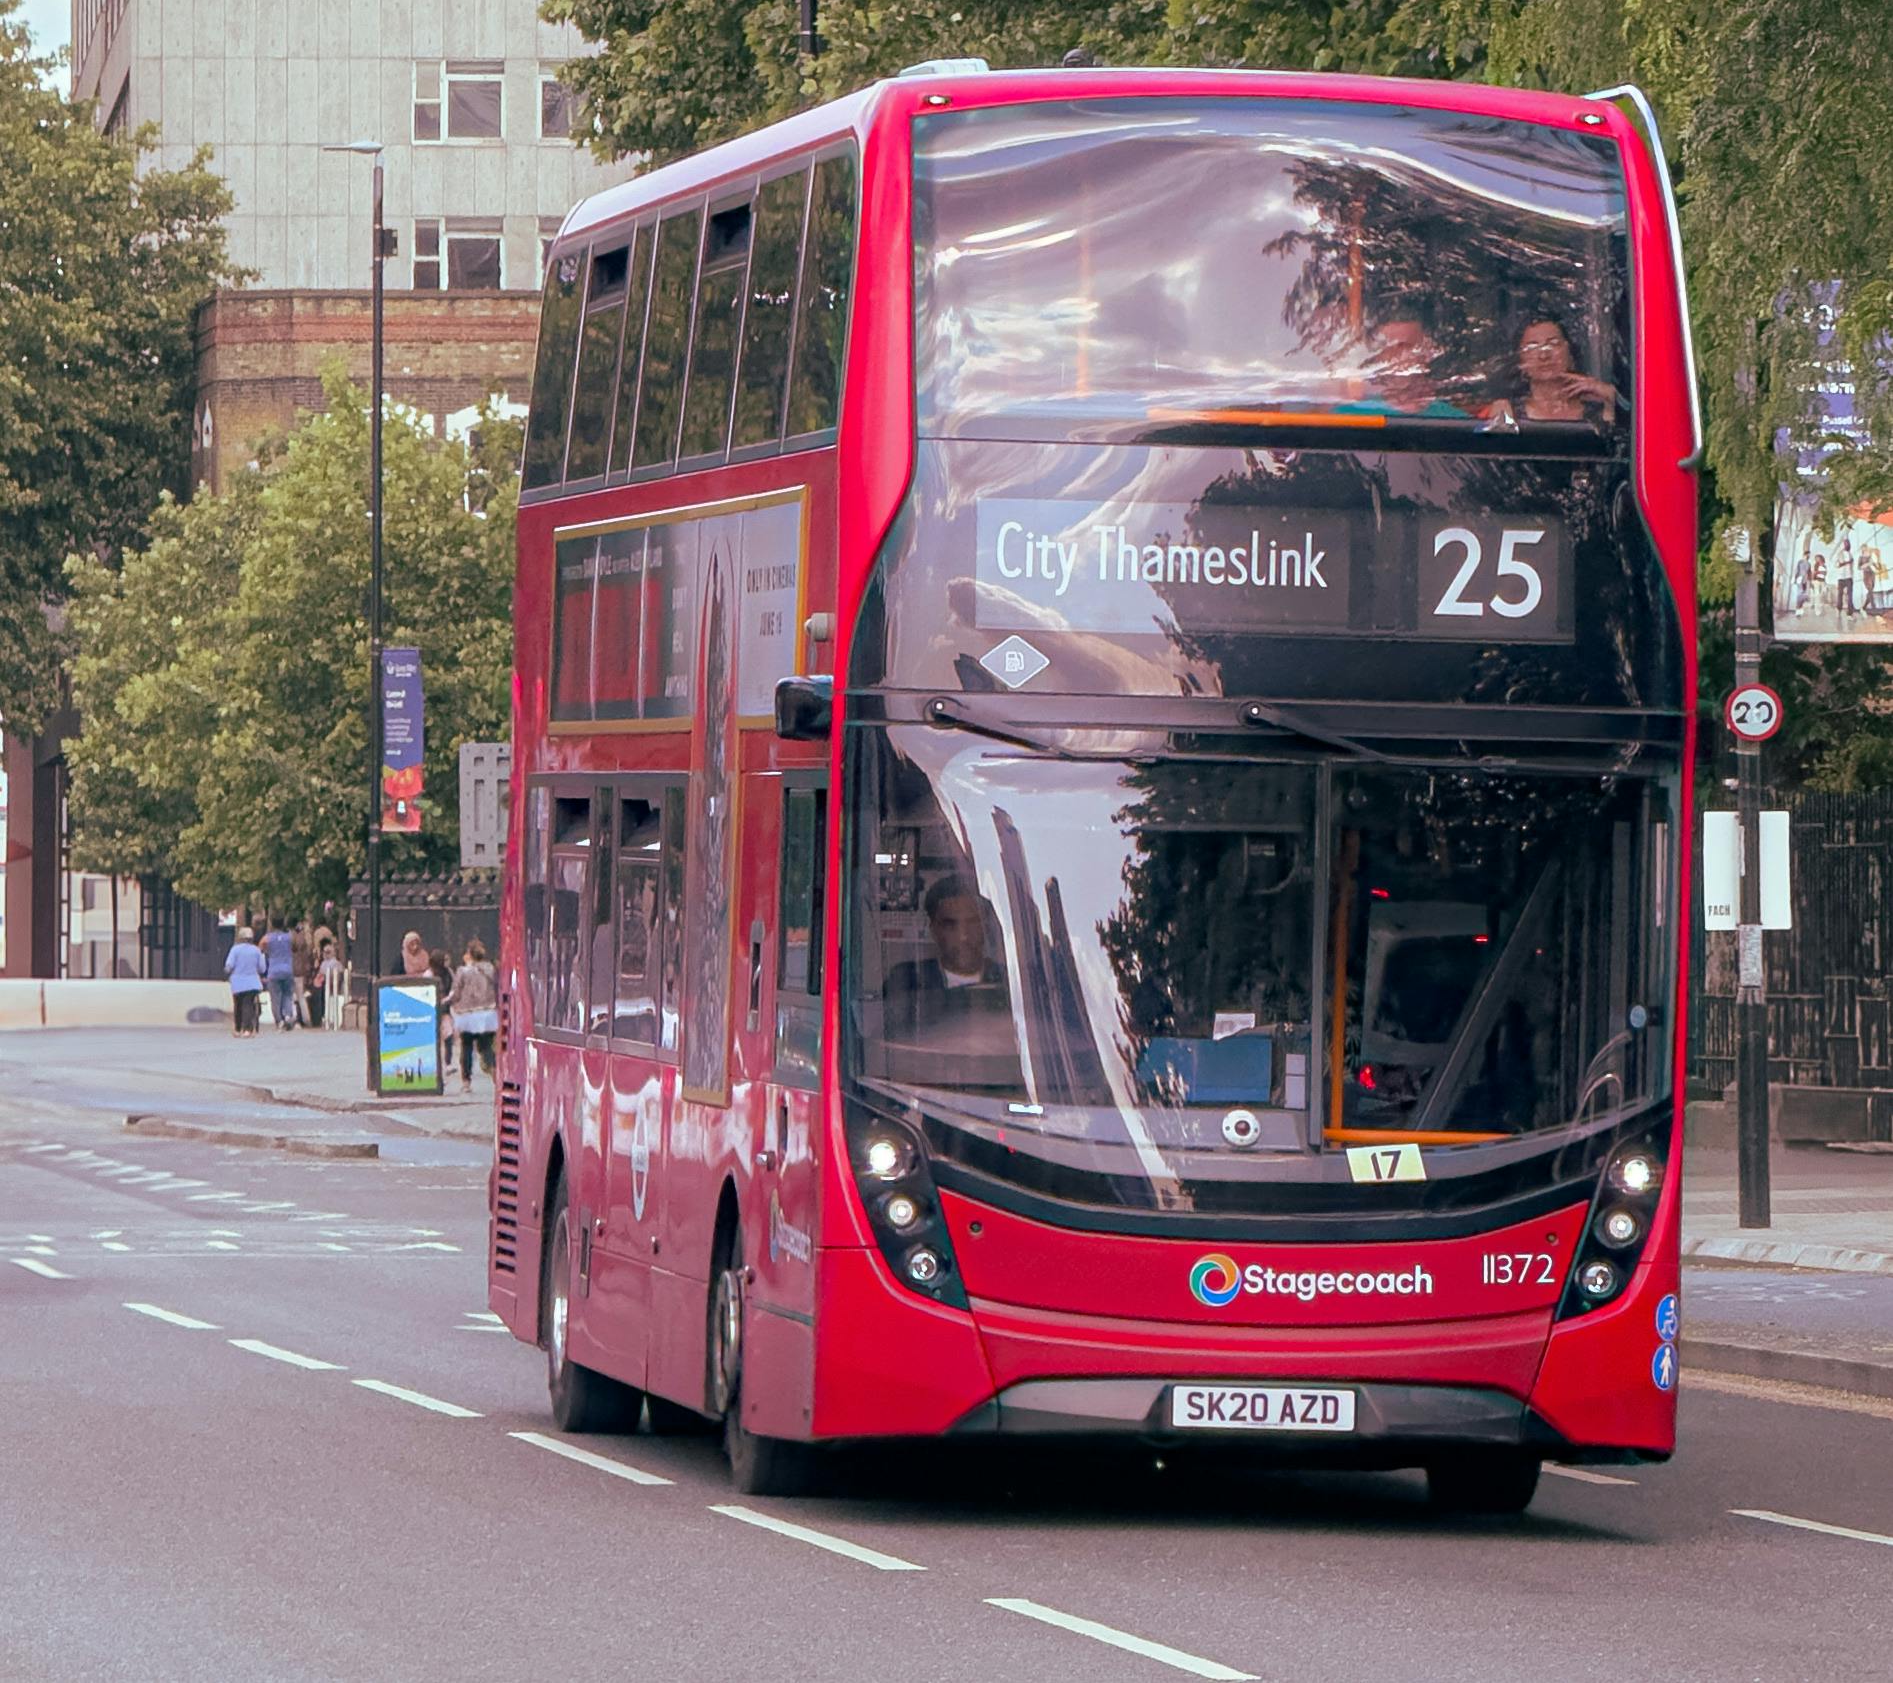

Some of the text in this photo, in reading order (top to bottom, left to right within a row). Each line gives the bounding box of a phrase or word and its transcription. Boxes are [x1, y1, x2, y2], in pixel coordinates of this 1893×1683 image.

[997, 521, 1328, 596] City Thameslink
[1433, 527, 1546, 618] 25
[1734, 701, 1773, 724] 20
[1370, 1150, 1402, 1180] 17
[1243, 1264, 1433, 1301] Stagecoach
[1483, 1253, 1555, 1284] 11372
[1187, 1391, 1340, 1425] SK20 AZD
